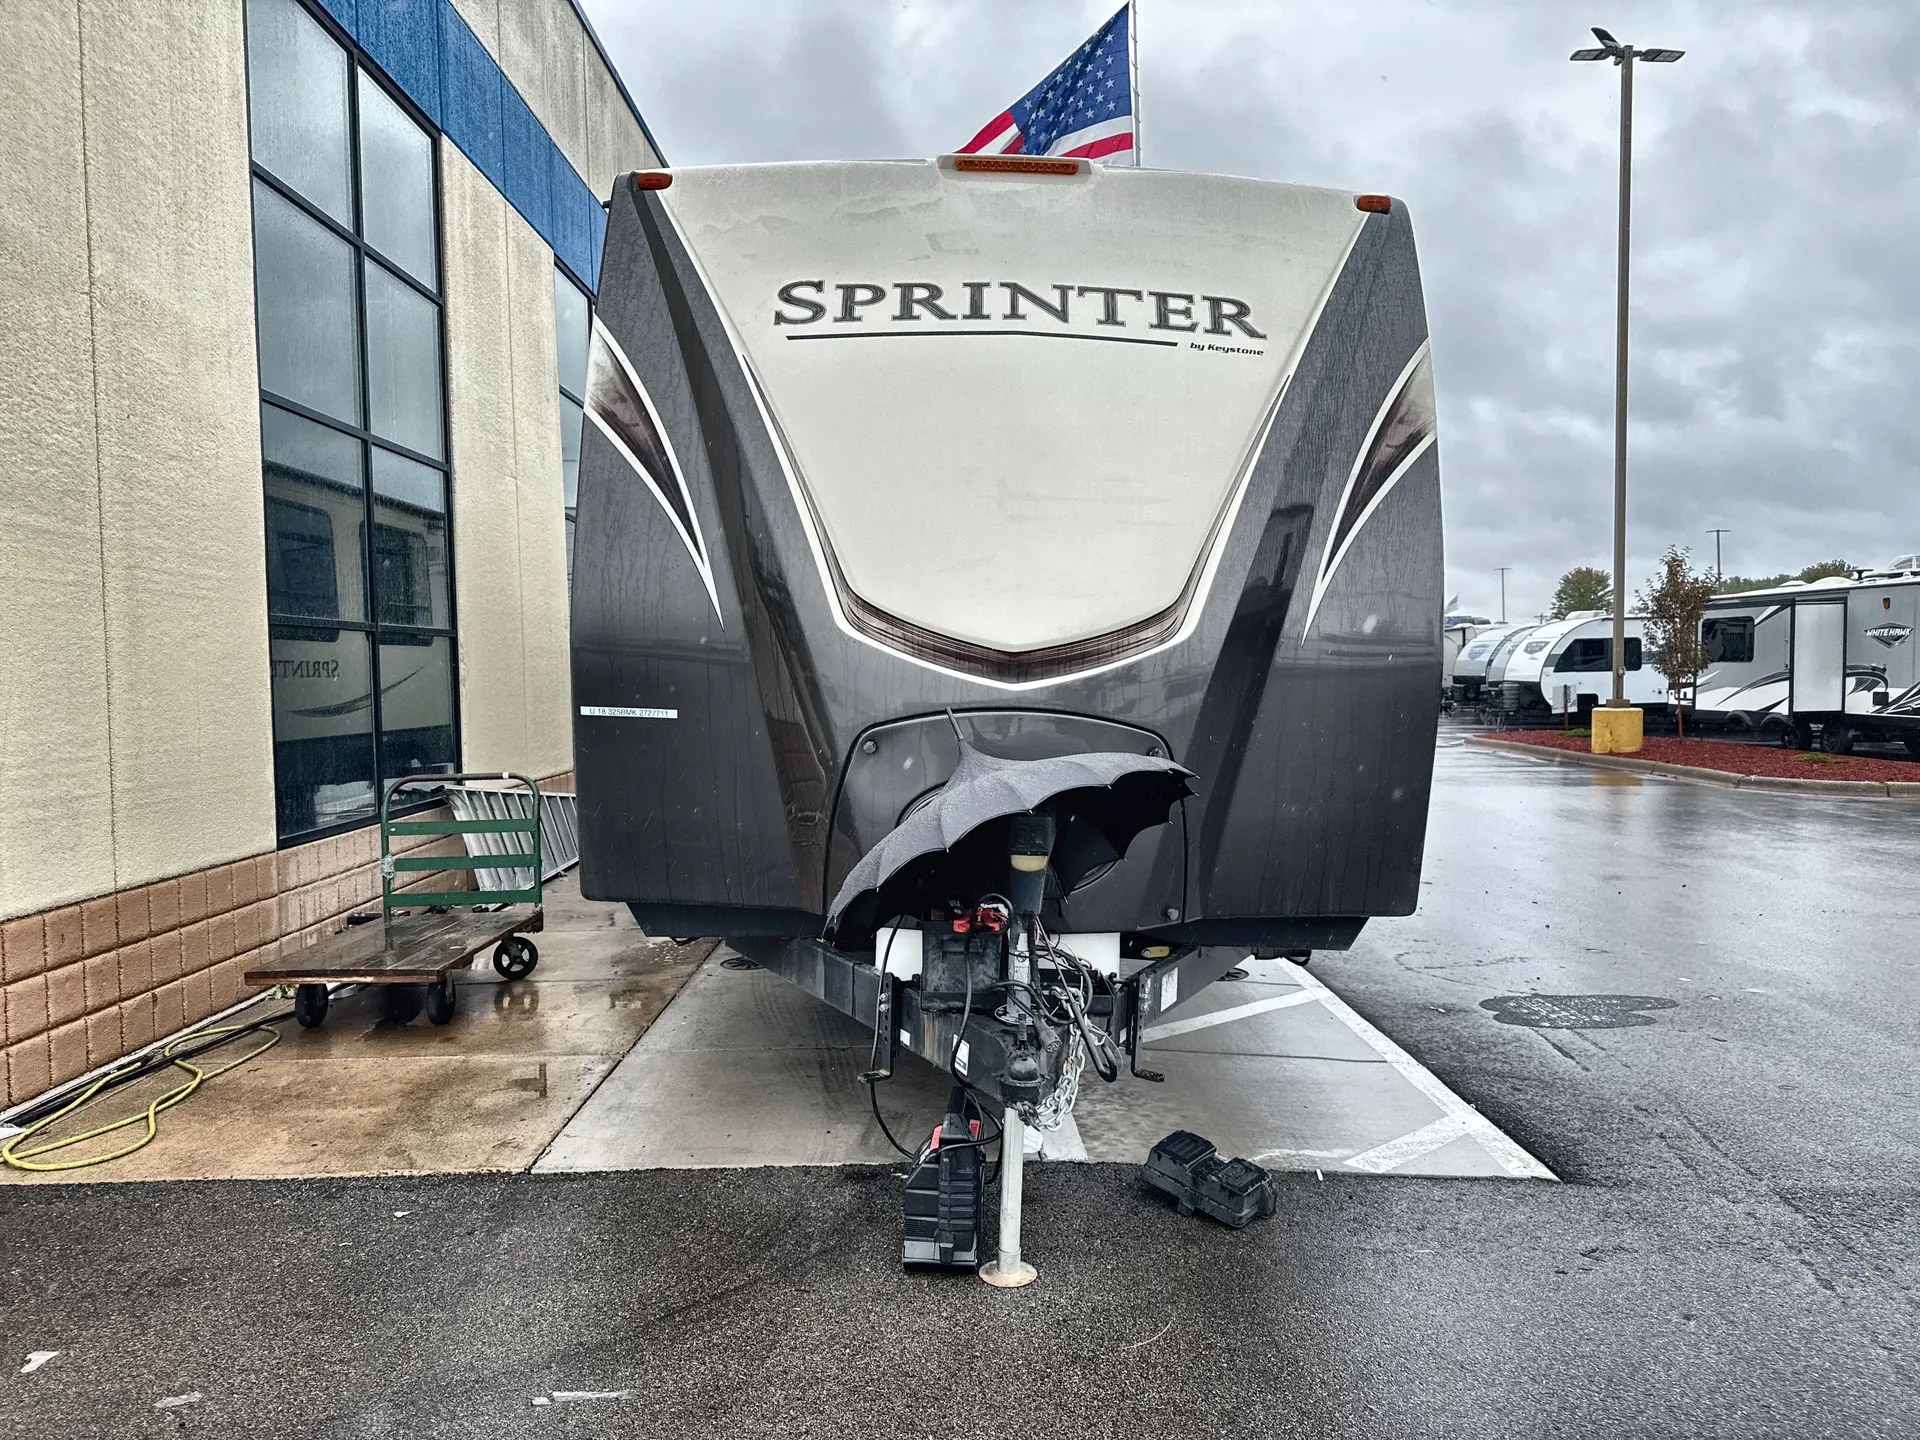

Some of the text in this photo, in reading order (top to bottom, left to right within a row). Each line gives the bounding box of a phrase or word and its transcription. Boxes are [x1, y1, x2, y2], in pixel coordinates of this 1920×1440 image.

[774, 280, 1267, 340] SPRINTER
[1190, 342, 1264, 356] by Keystone
[608, 708, 637, 716] 325BMK
